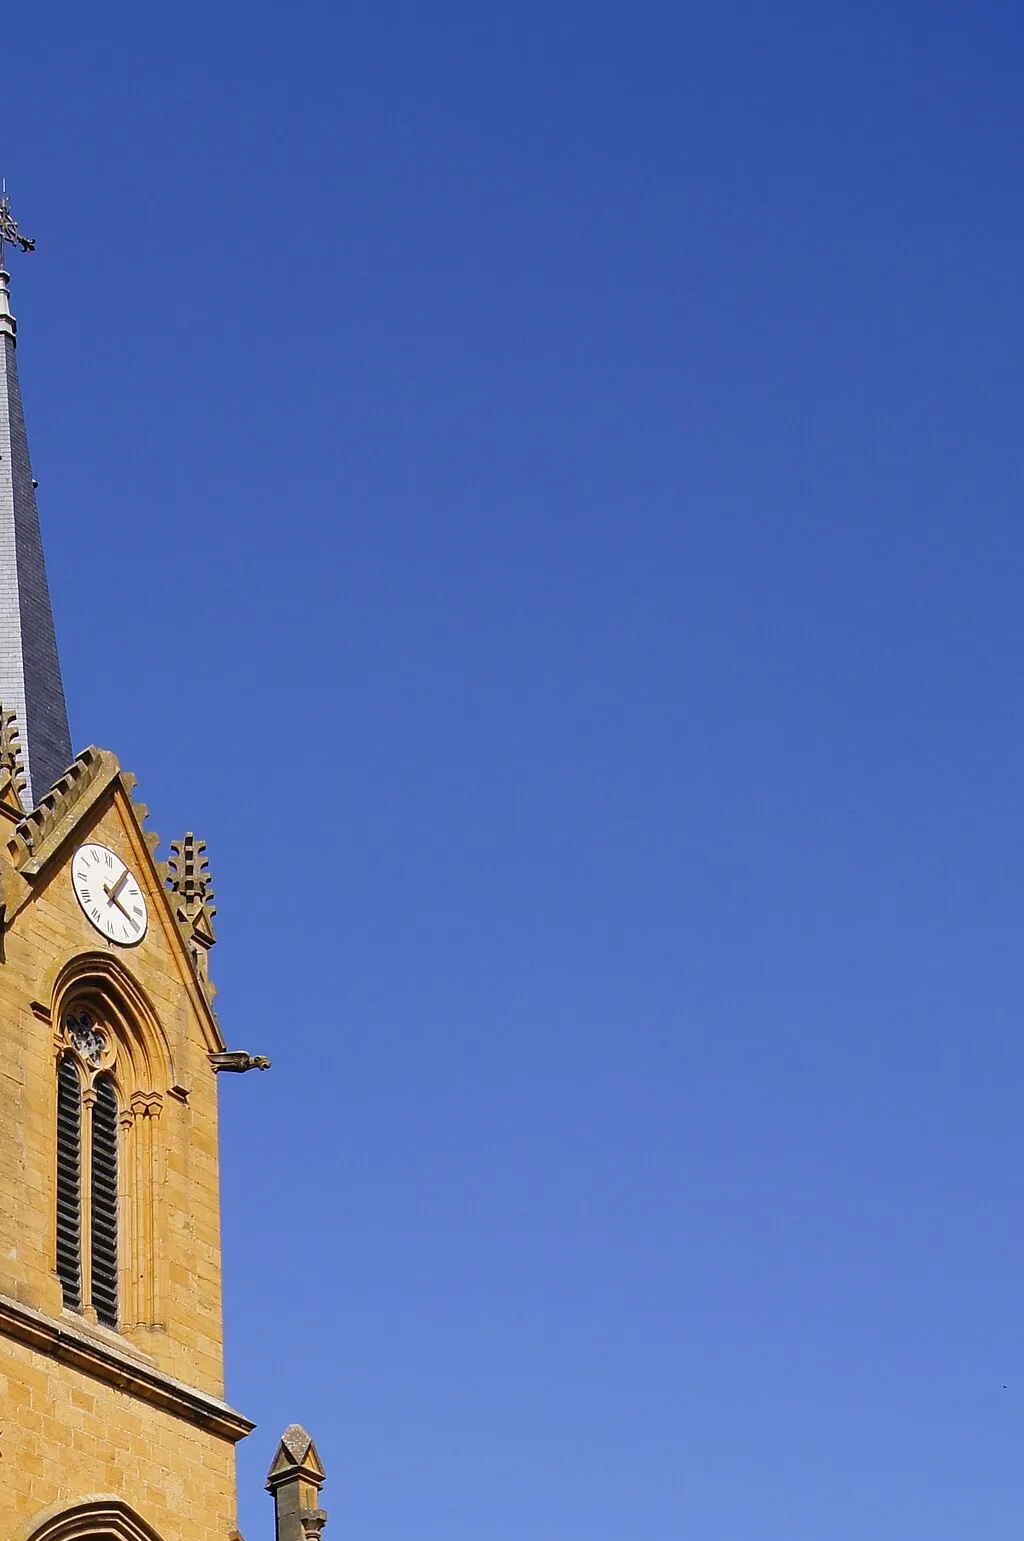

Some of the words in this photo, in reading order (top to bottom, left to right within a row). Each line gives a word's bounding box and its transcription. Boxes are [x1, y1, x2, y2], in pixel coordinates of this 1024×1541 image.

[104, 853, 112, 868] XII
[80, 889, 92, 903] VIII
[91, 908, 101, 922] VII
[107, 920, 114, 935] VI
